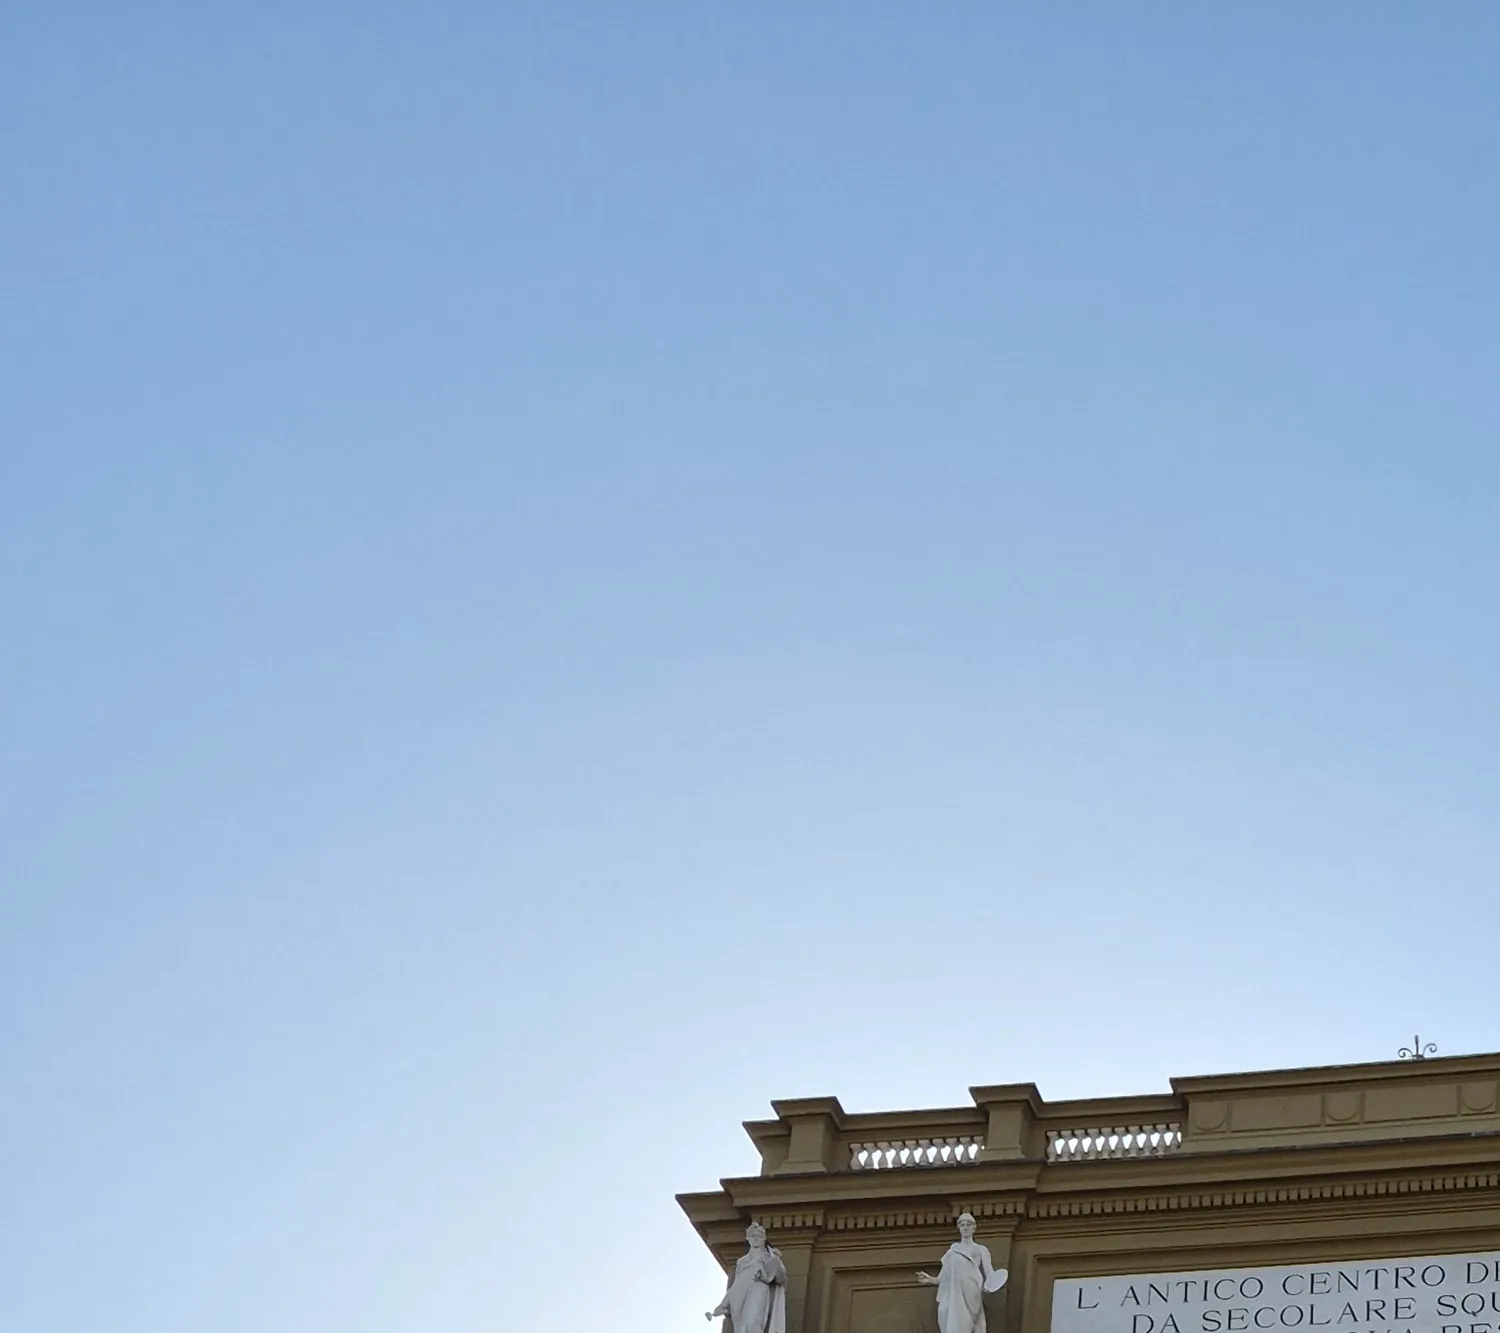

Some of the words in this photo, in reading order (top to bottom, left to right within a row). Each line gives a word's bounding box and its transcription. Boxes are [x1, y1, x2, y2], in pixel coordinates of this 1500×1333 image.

[1119, 1276, 1264, 1307] ANTICO
[1281, 1263, 1446, 1297] CENTRO
[1201, 1297, 1417, 1332] SECOLARE
